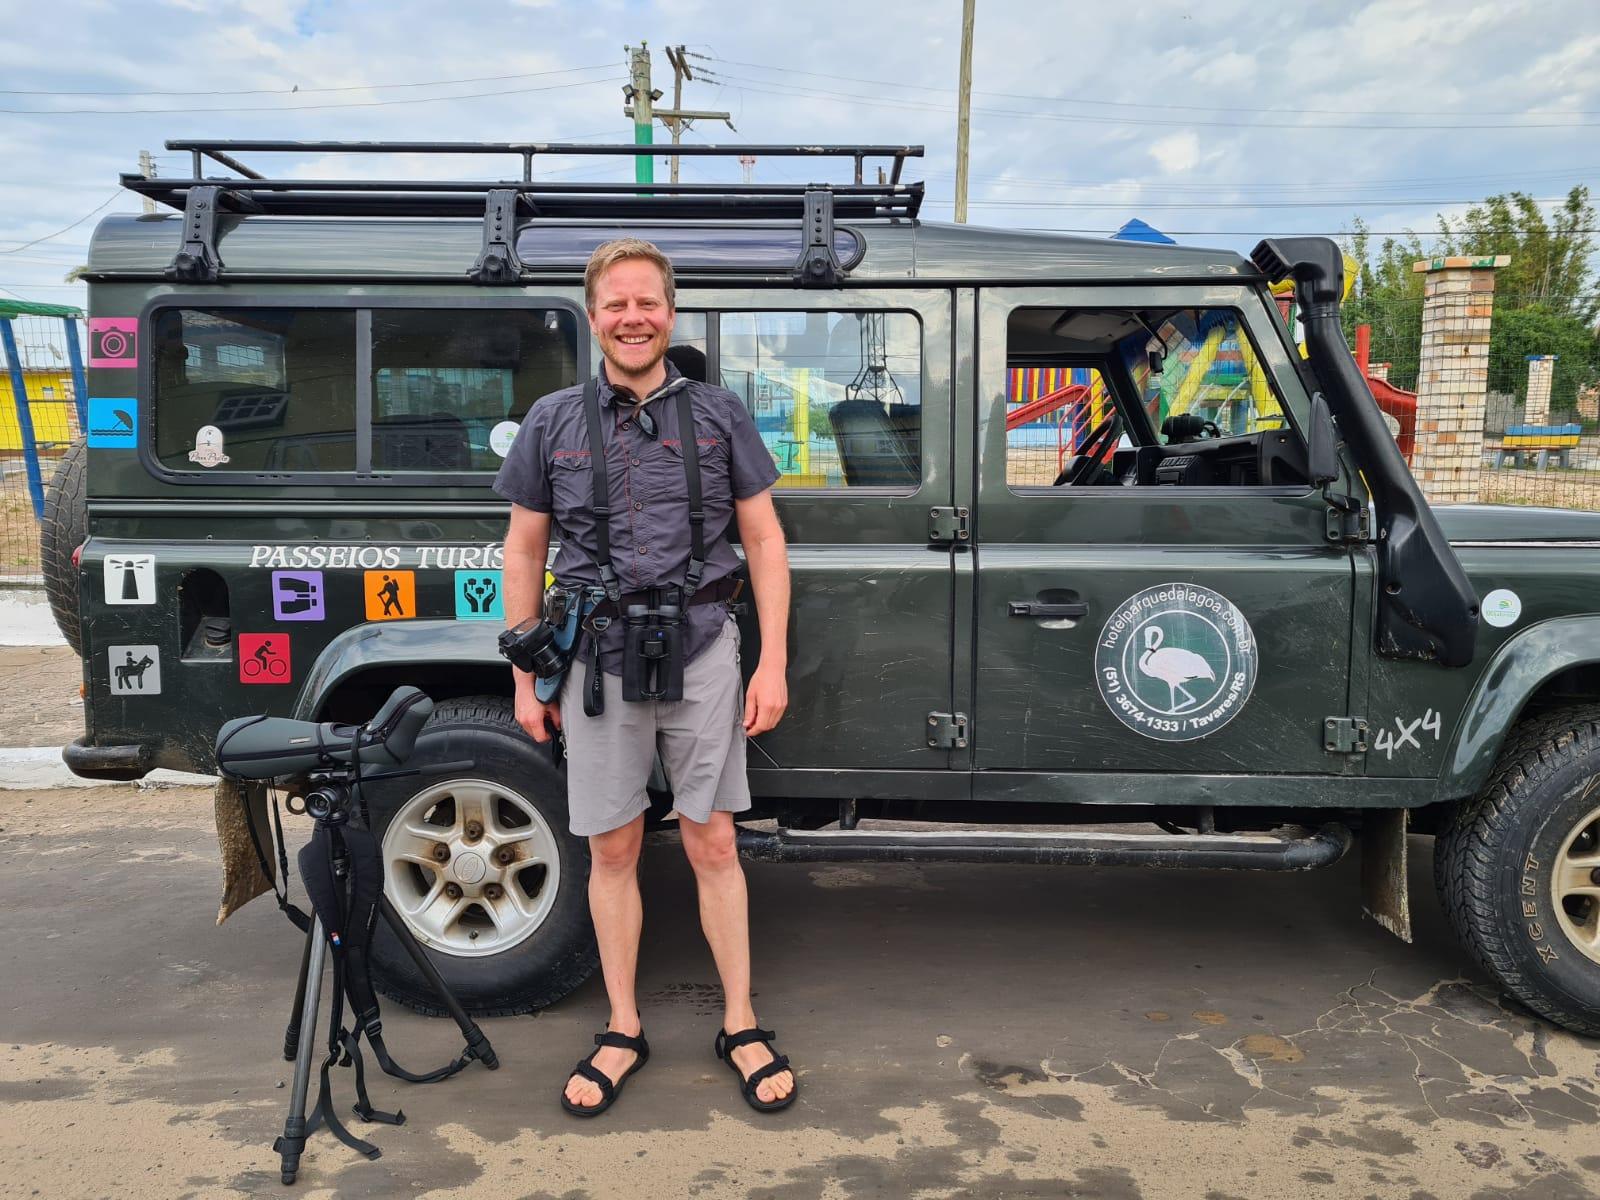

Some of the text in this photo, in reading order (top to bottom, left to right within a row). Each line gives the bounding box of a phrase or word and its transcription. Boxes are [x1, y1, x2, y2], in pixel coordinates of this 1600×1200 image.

[248, 542, 504, 569] PASSEIOS TURÍS
[1102, 586, 1251, 654] hotelparquedalagoa.com.br
[1102, 666, 1122, 694] (51)
[1116, 694, 1179, 732] 3674-1333
[1189, 671, 1246, 730] Tavares/RS
[1521, 852, 1560, 966] XCENT
